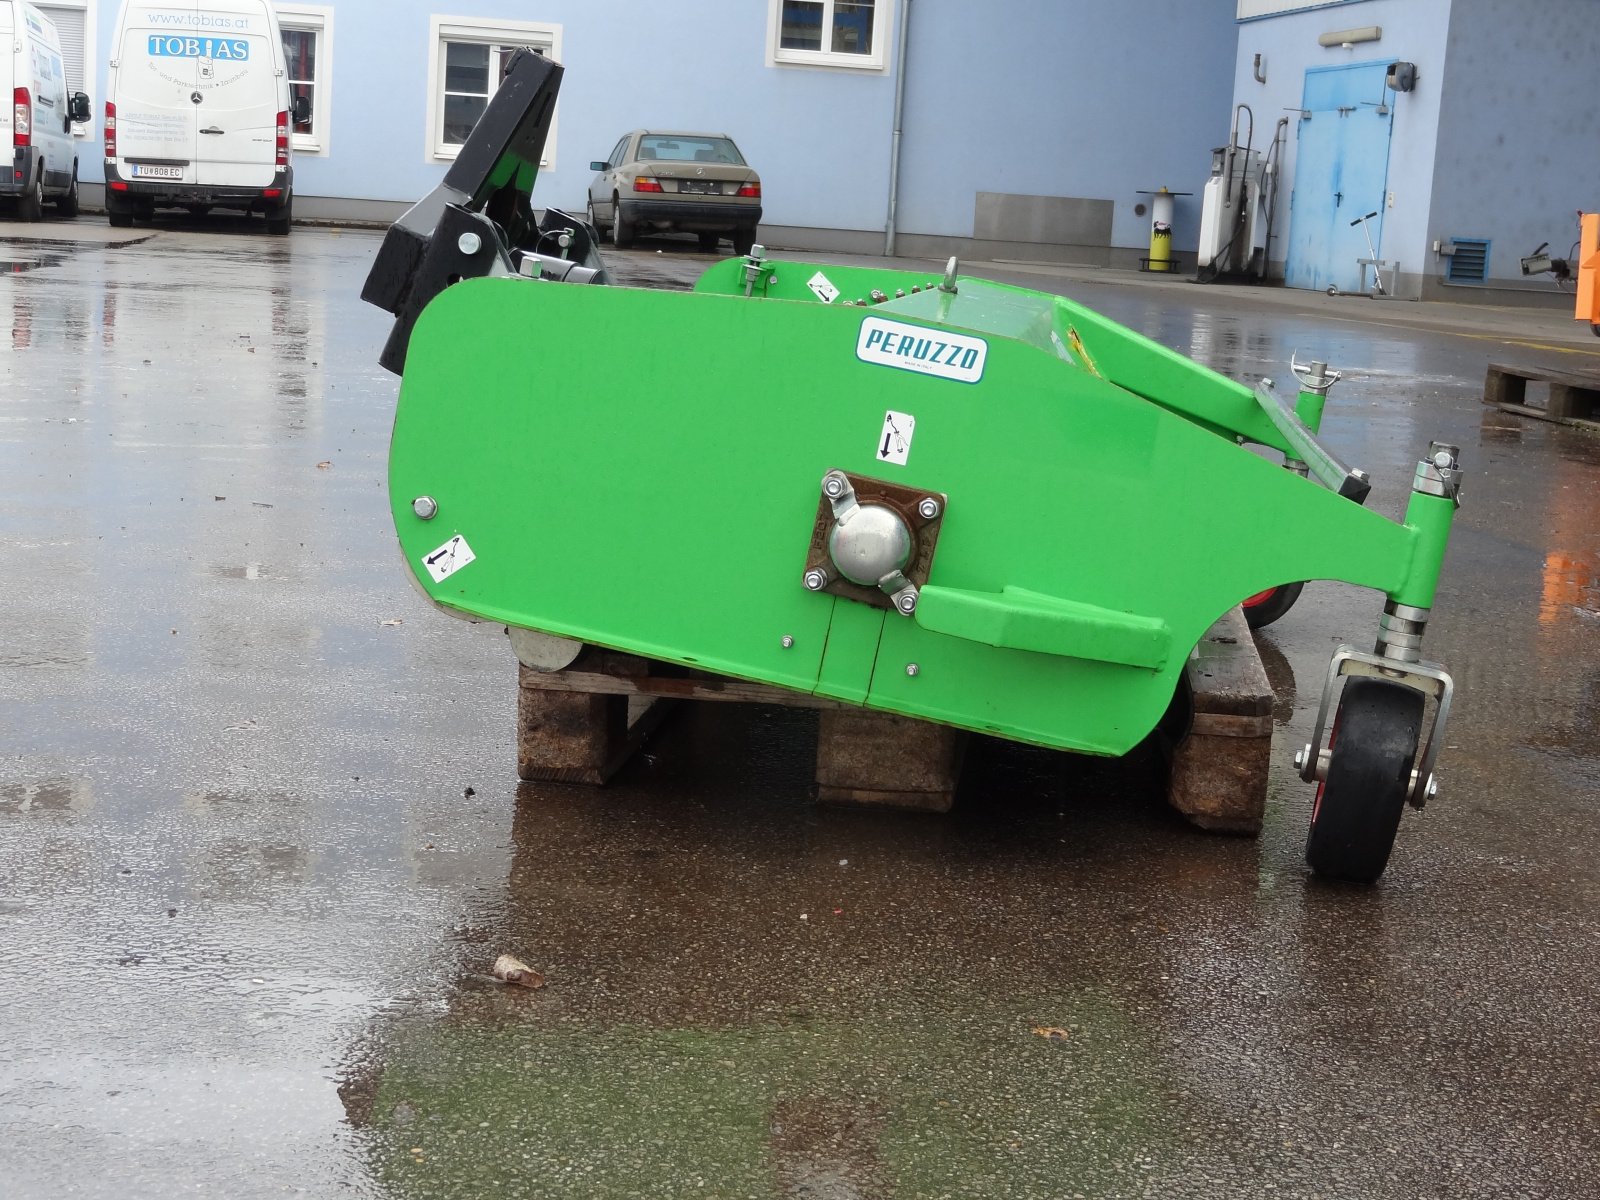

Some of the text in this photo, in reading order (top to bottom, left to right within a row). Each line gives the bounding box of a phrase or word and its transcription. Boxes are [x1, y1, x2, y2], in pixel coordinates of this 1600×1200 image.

[148, 14, 249, 29] www.tobias.at
[150, 37, 247, 59] TOBIAS
[865, 329, 979, 370] PERUZZO
